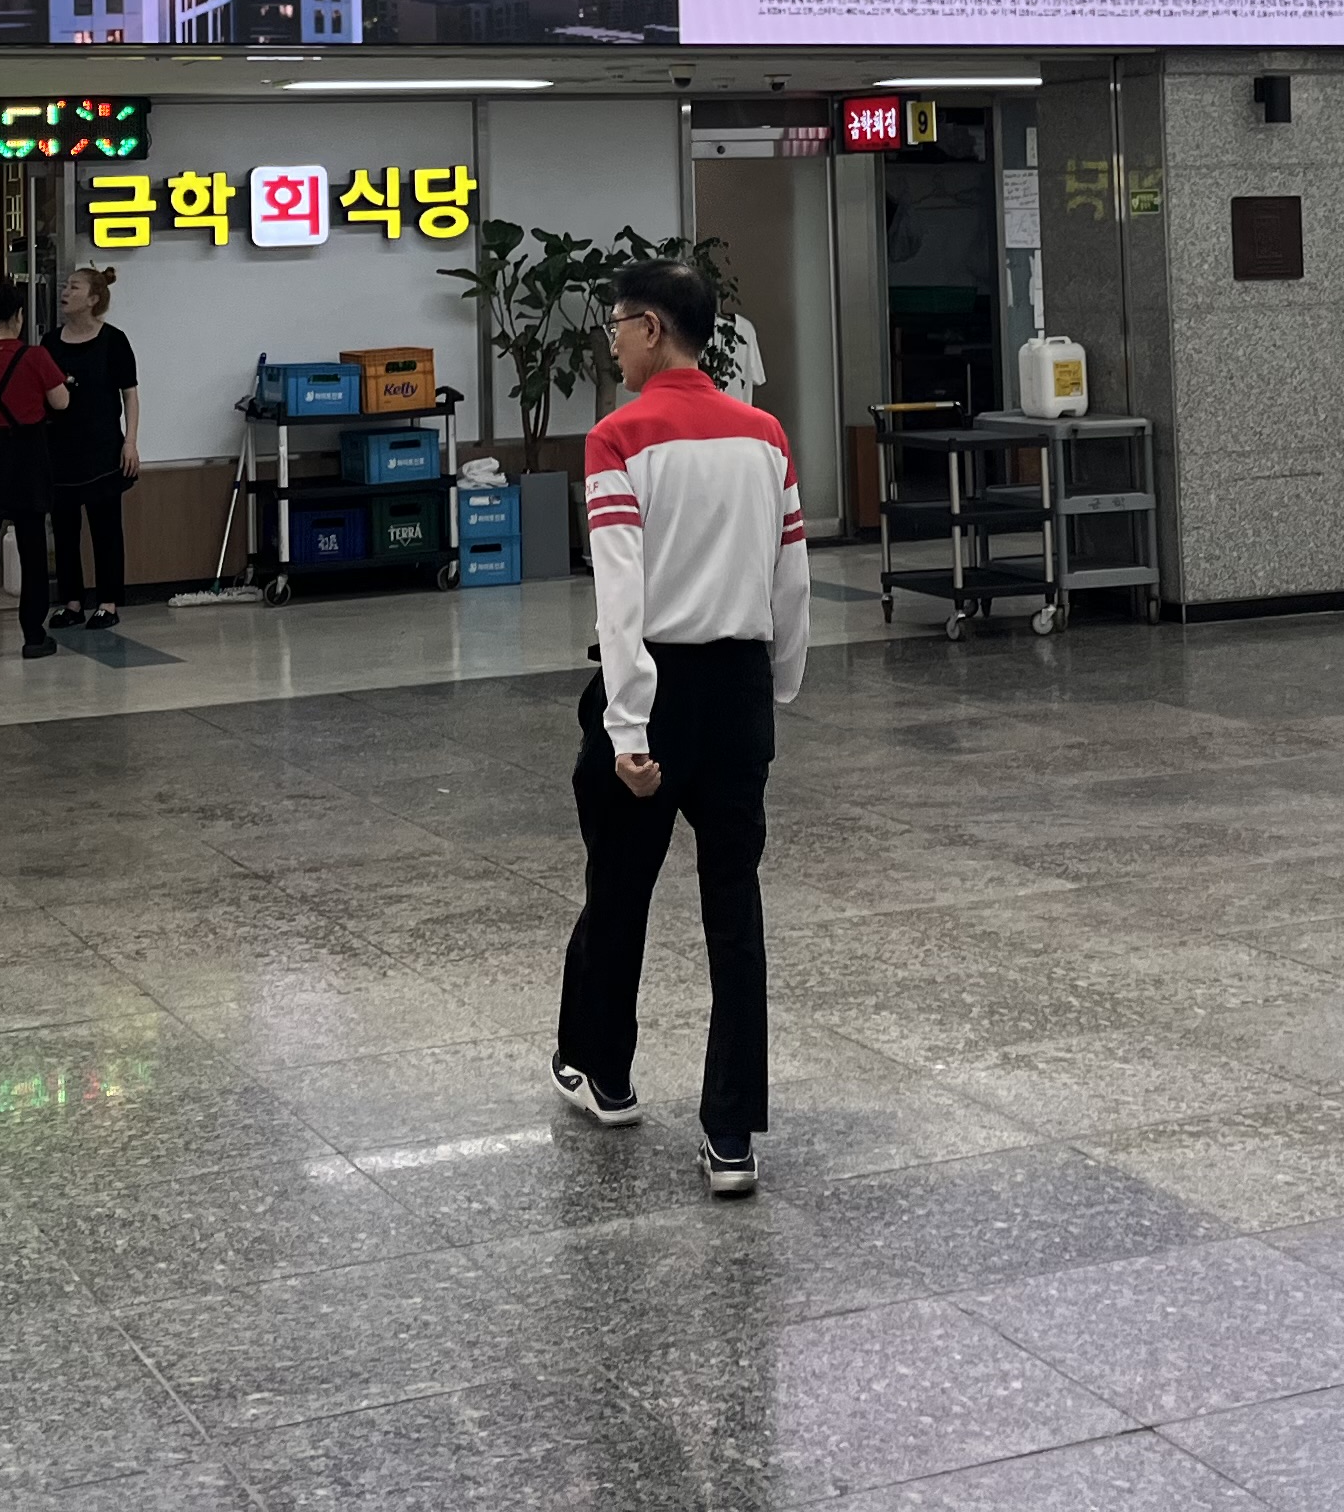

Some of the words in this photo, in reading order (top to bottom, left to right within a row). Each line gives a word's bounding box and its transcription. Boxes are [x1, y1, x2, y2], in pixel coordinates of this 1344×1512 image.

[848, 107, 897, 140] 금학회집
[918, 110, 928, 134] 9
[88, 170, 237, 249] 금학
[260, 174, 320, 237] 회
[339, 164, 478, 241] 식당
[383, 381, 419, 399] Kelly
[387, 522, 423, 541] TERRA
